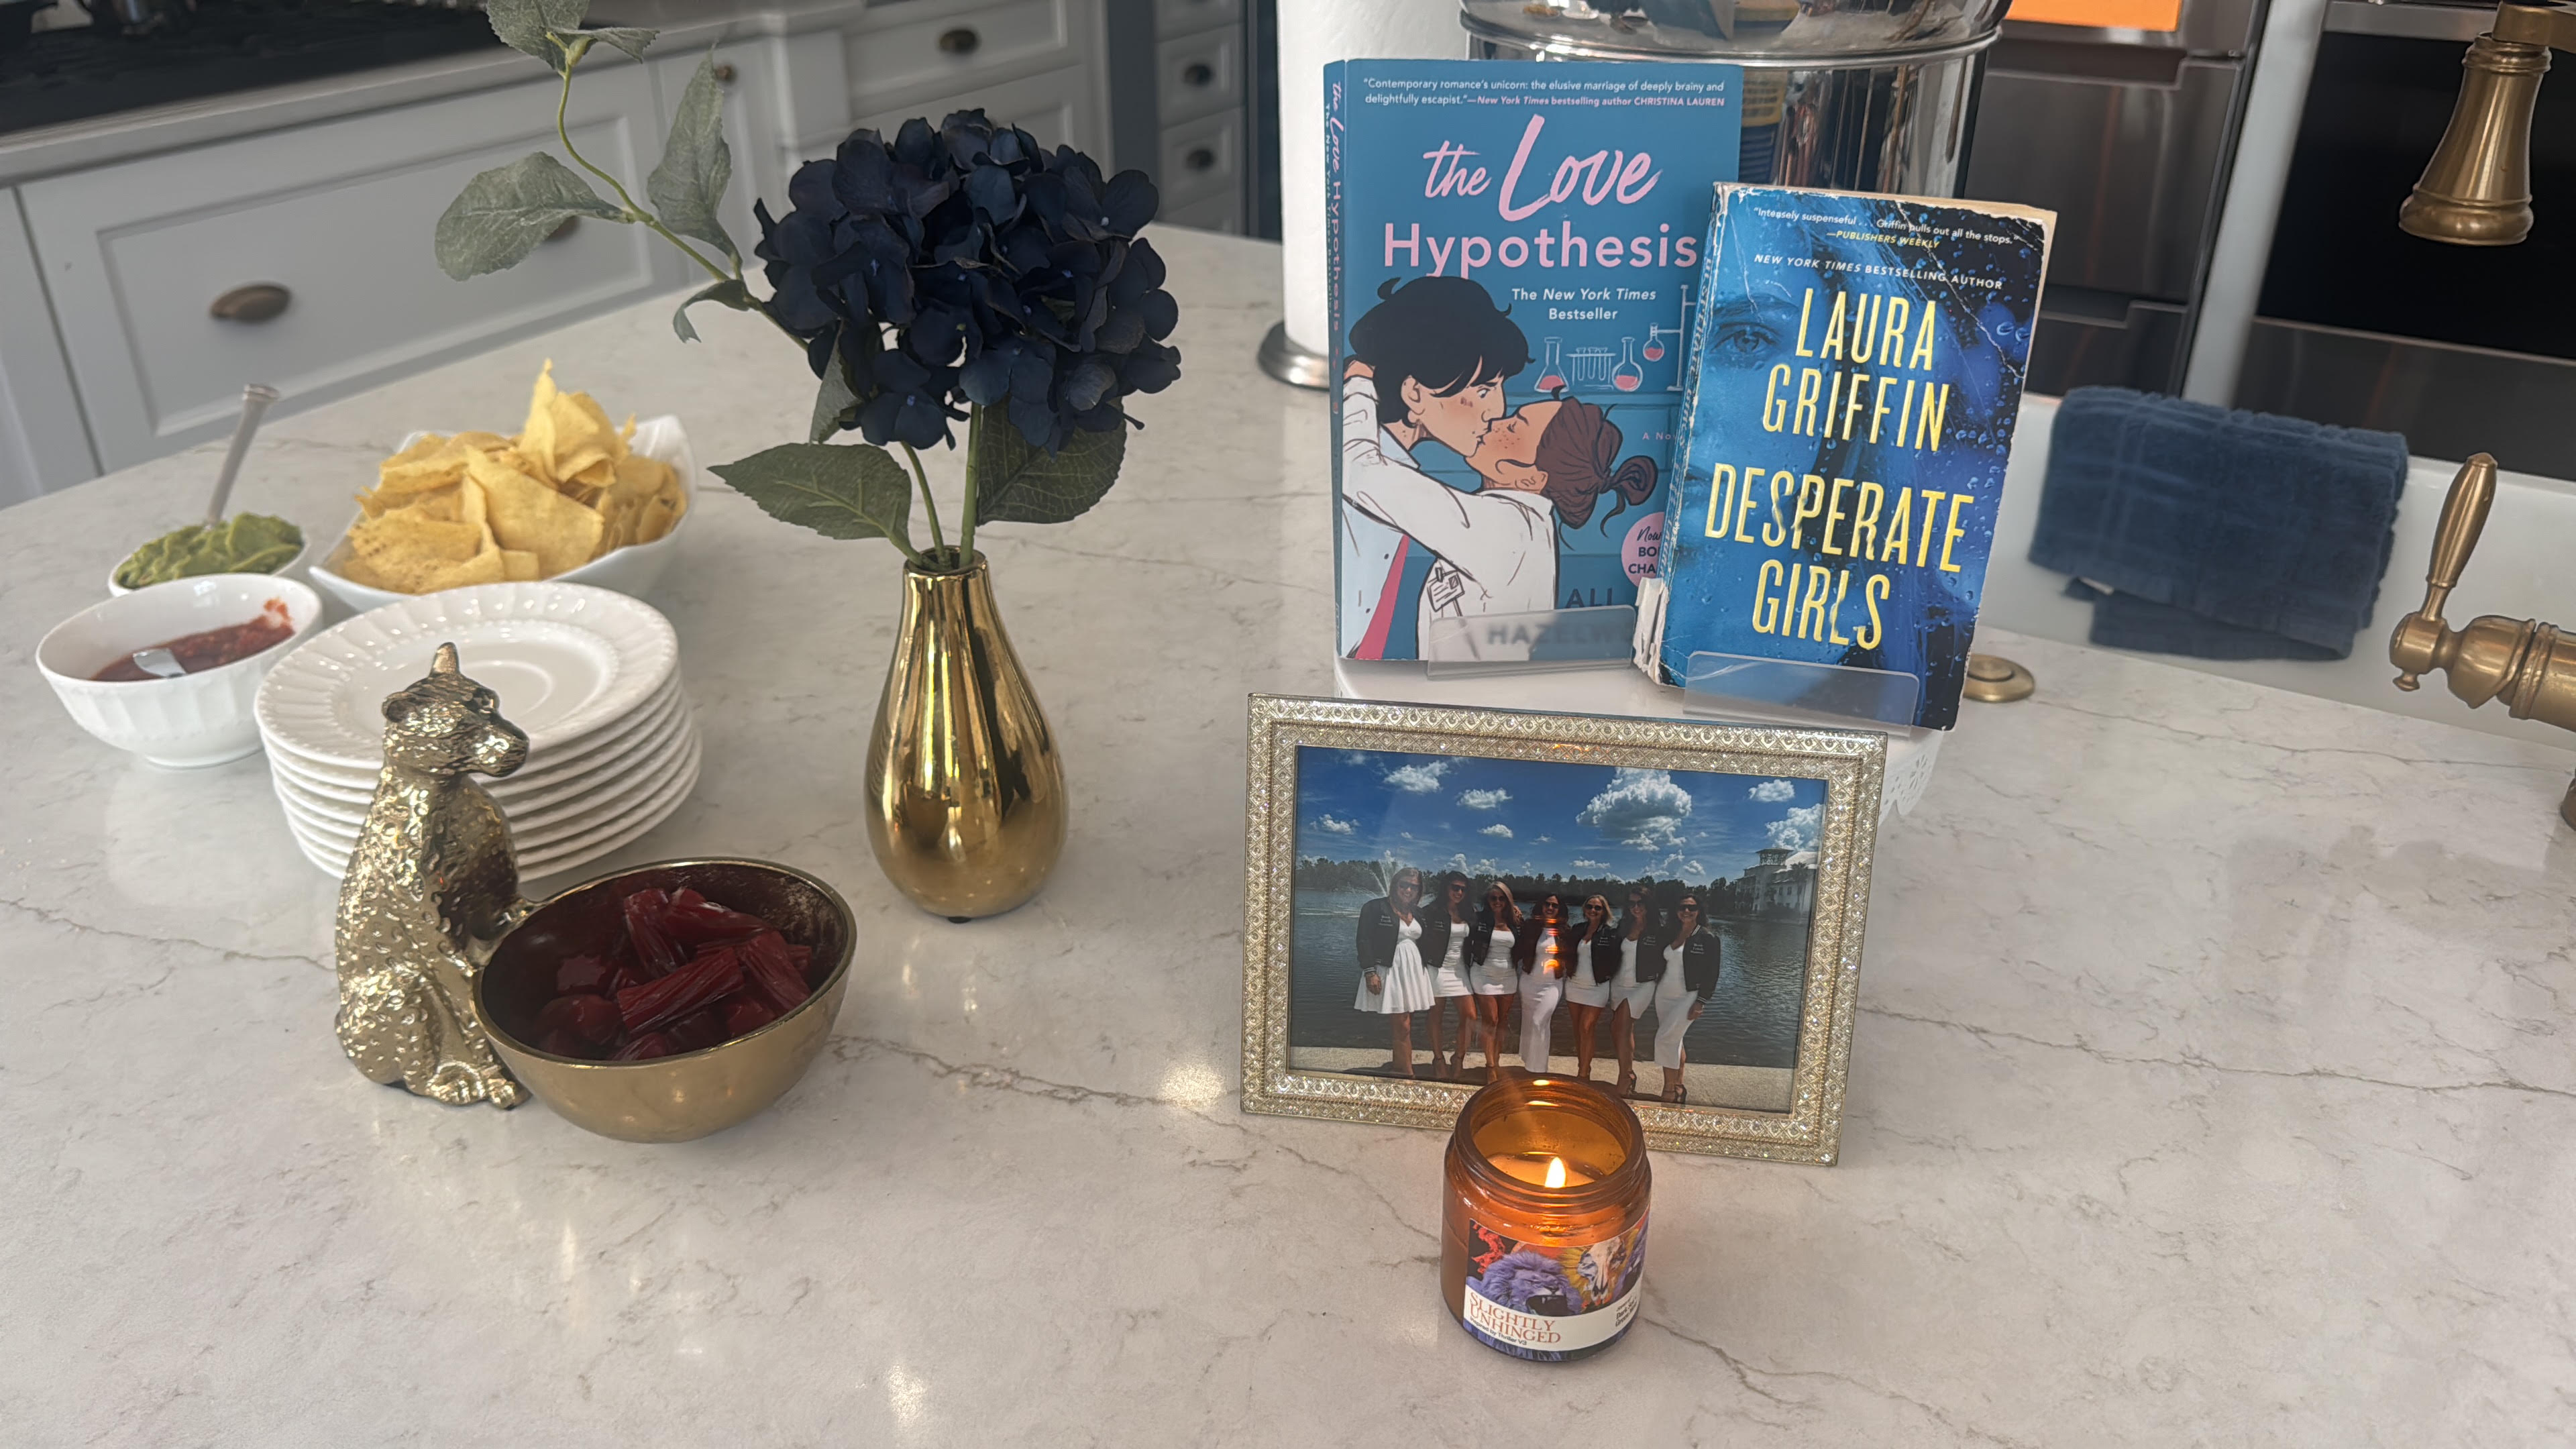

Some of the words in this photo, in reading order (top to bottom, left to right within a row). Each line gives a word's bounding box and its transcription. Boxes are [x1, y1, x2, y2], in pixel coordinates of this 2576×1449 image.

[1364, 78, 1438, 91] "Contemporary
[1440, 79, 1488, 90] romance's
[1491, 80, 1528, 90] unicorn:
[1531, 80, 1546, 90] the
[1549, 80, 1581, 91] elusive
[1584, 81, 1625, 92] marriage
[1628, 80, 1638, 91] of
[1641, 80, 1672, 93] deeply
[1675, 81, 1703, 93] brainy
[1707, 80, 1725, 92] and
[1365, 93, 1419, 106] delightfully
[1501, 96, 1520, 105] York
[1523, 96, 1549, 105] Times
[1551, 96, 1599, 107] bestselling
[1602, 96, 1631, 106] author
[1634, 97, 1684, 107] CHRISTINA
[1686, 97, 1725, 107] LAUREN
[1423, 140, 1493, 199] the
[1498, 114, 1664, 223] Love
[1754, 207, 1800, 221] "Intensely
[1802, 213, 1857, 225] suspenseful
[1876, 218, 1907, 230] Griffin
[1909, 223, 1931, 233] pulls
[1933, 227, 1949, 236] out
[1952, 229, 1964, 237] all
[1966, 230, 1981, 240] the
[1385, 221, 1698, 279] Hypothesis
[1900, 237, 1940, 249] WEEKLY
[1754, 254, 1783, 264] NEW
[1787, 258, 1820, 269] YORK
[1825, 260, 1861, 273] TIMES
[1865, 264, 1946, 282] BESTSELLING
[1951, 274, 2002, 290] AUTHOR
[1511, 288, 1537, 301] The
[1543, 288, 1575, 301] New
[1580, 288, 1611, 301] York
[1616, 288, 1656, 301] Times
[1548, 307, 1618, 320] Bestseller
[1795, 288, 1936, 371] LAURA
[1762, 364, 1949, 452] GRIFFIN
[1642, 432, 1650, 440] A
[1705, 463, 1974, 573] DESPERATE
[1752, 559, 1890, 651] GIRLS
[1470, 1291, 1556, 1331] SLIGHTLY
[1470, 1303, 1561, 1343] UNHINGED
